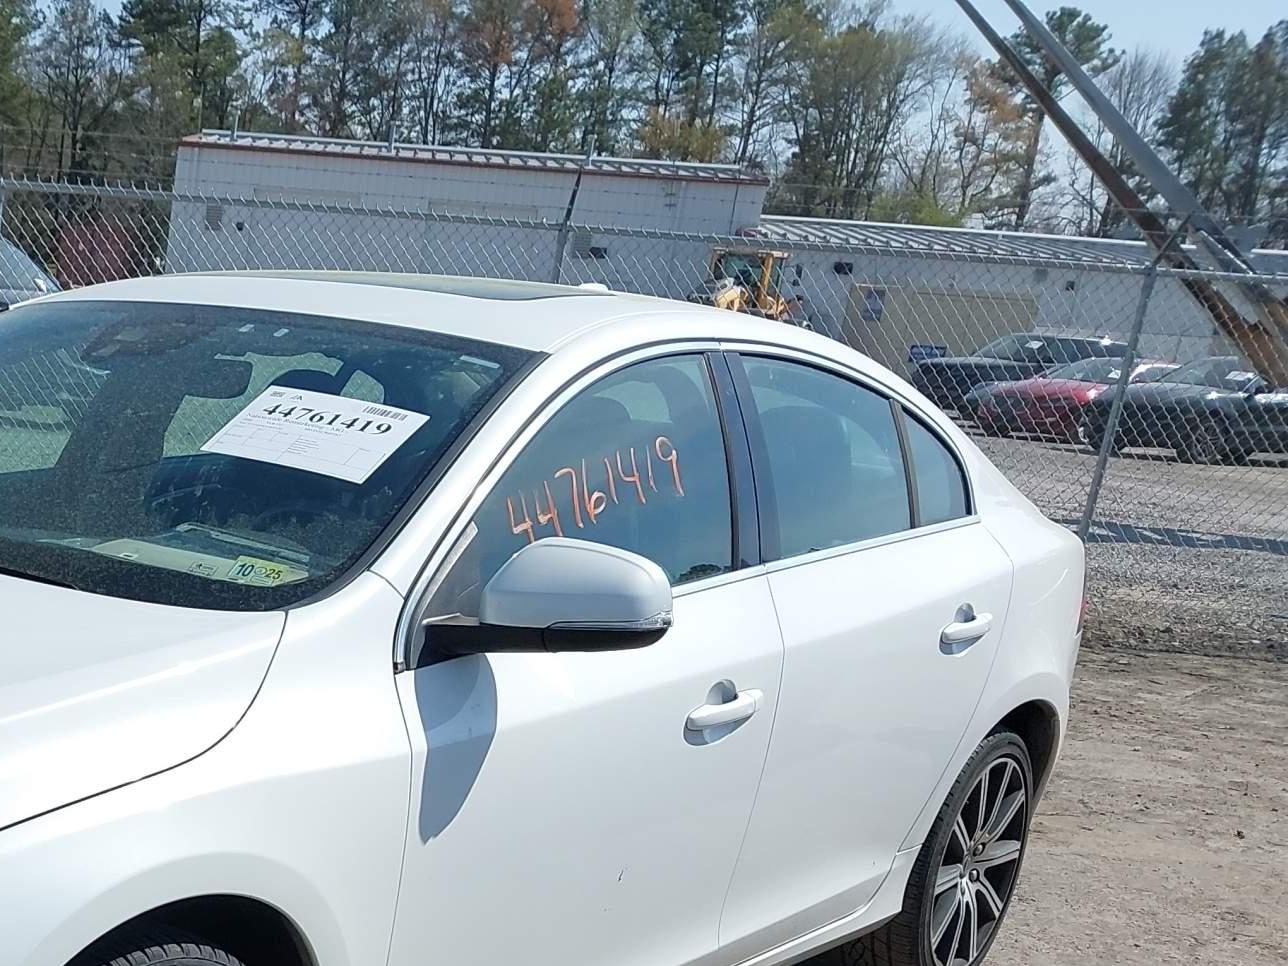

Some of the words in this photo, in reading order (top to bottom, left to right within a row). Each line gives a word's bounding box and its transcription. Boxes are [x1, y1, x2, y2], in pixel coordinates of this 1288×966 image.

[263, 403, 392, 435] 44761419
[506, 436, 684, 544] 44761419
[236, 562, 255, 577] 10
[264, 568, 283, 580] 25
